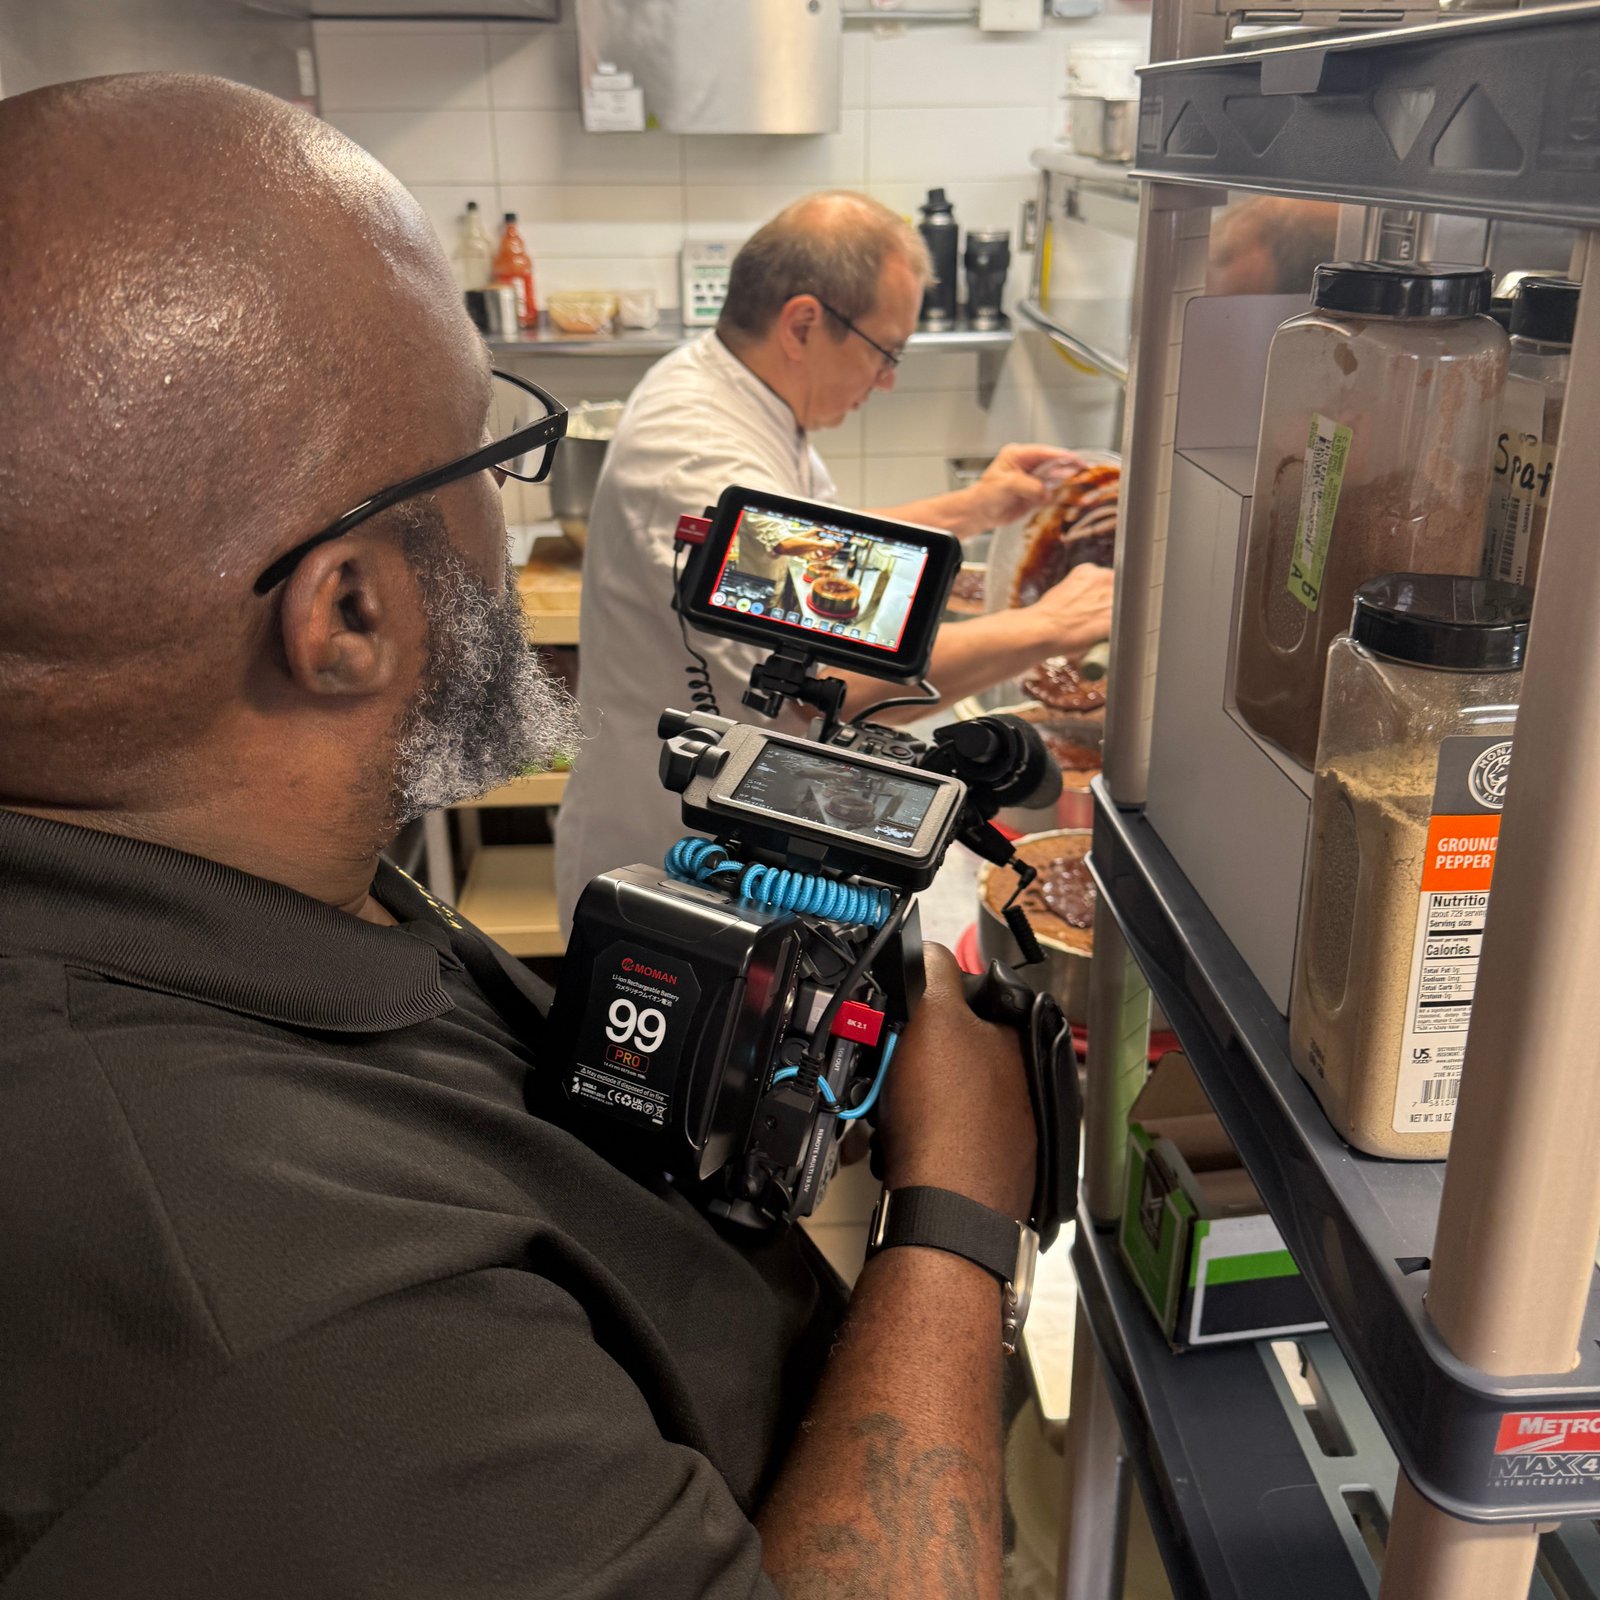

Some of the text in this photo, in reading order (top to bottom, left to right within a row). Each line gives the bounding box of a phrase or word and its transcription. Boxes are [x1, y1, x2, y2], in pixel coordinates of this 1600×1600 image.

[1400, 240, 1410, 258] 2
[1438, 837, 1498, 852] GROUND
[1435, 854, 1492, 869] PEPPER
[1430, 920, 1456, 928] Serving
[1426, 944, 1471, 956] Calories
[635, 964, 678, 985] MOMAN
[605, 999, 666, 1053] 99
[614, 1049, 640, 1068] PRO
[587, 1069, 597, 1078] May
[597, 1072, 616, 1086] explode
[621, 1081, 643, 1095] disposed
[813, 1128, 824, 1154] REMOTE
[808, 1155, 817, 1174] MULTI
[1518, 1416, 1600, 1435] METRO
